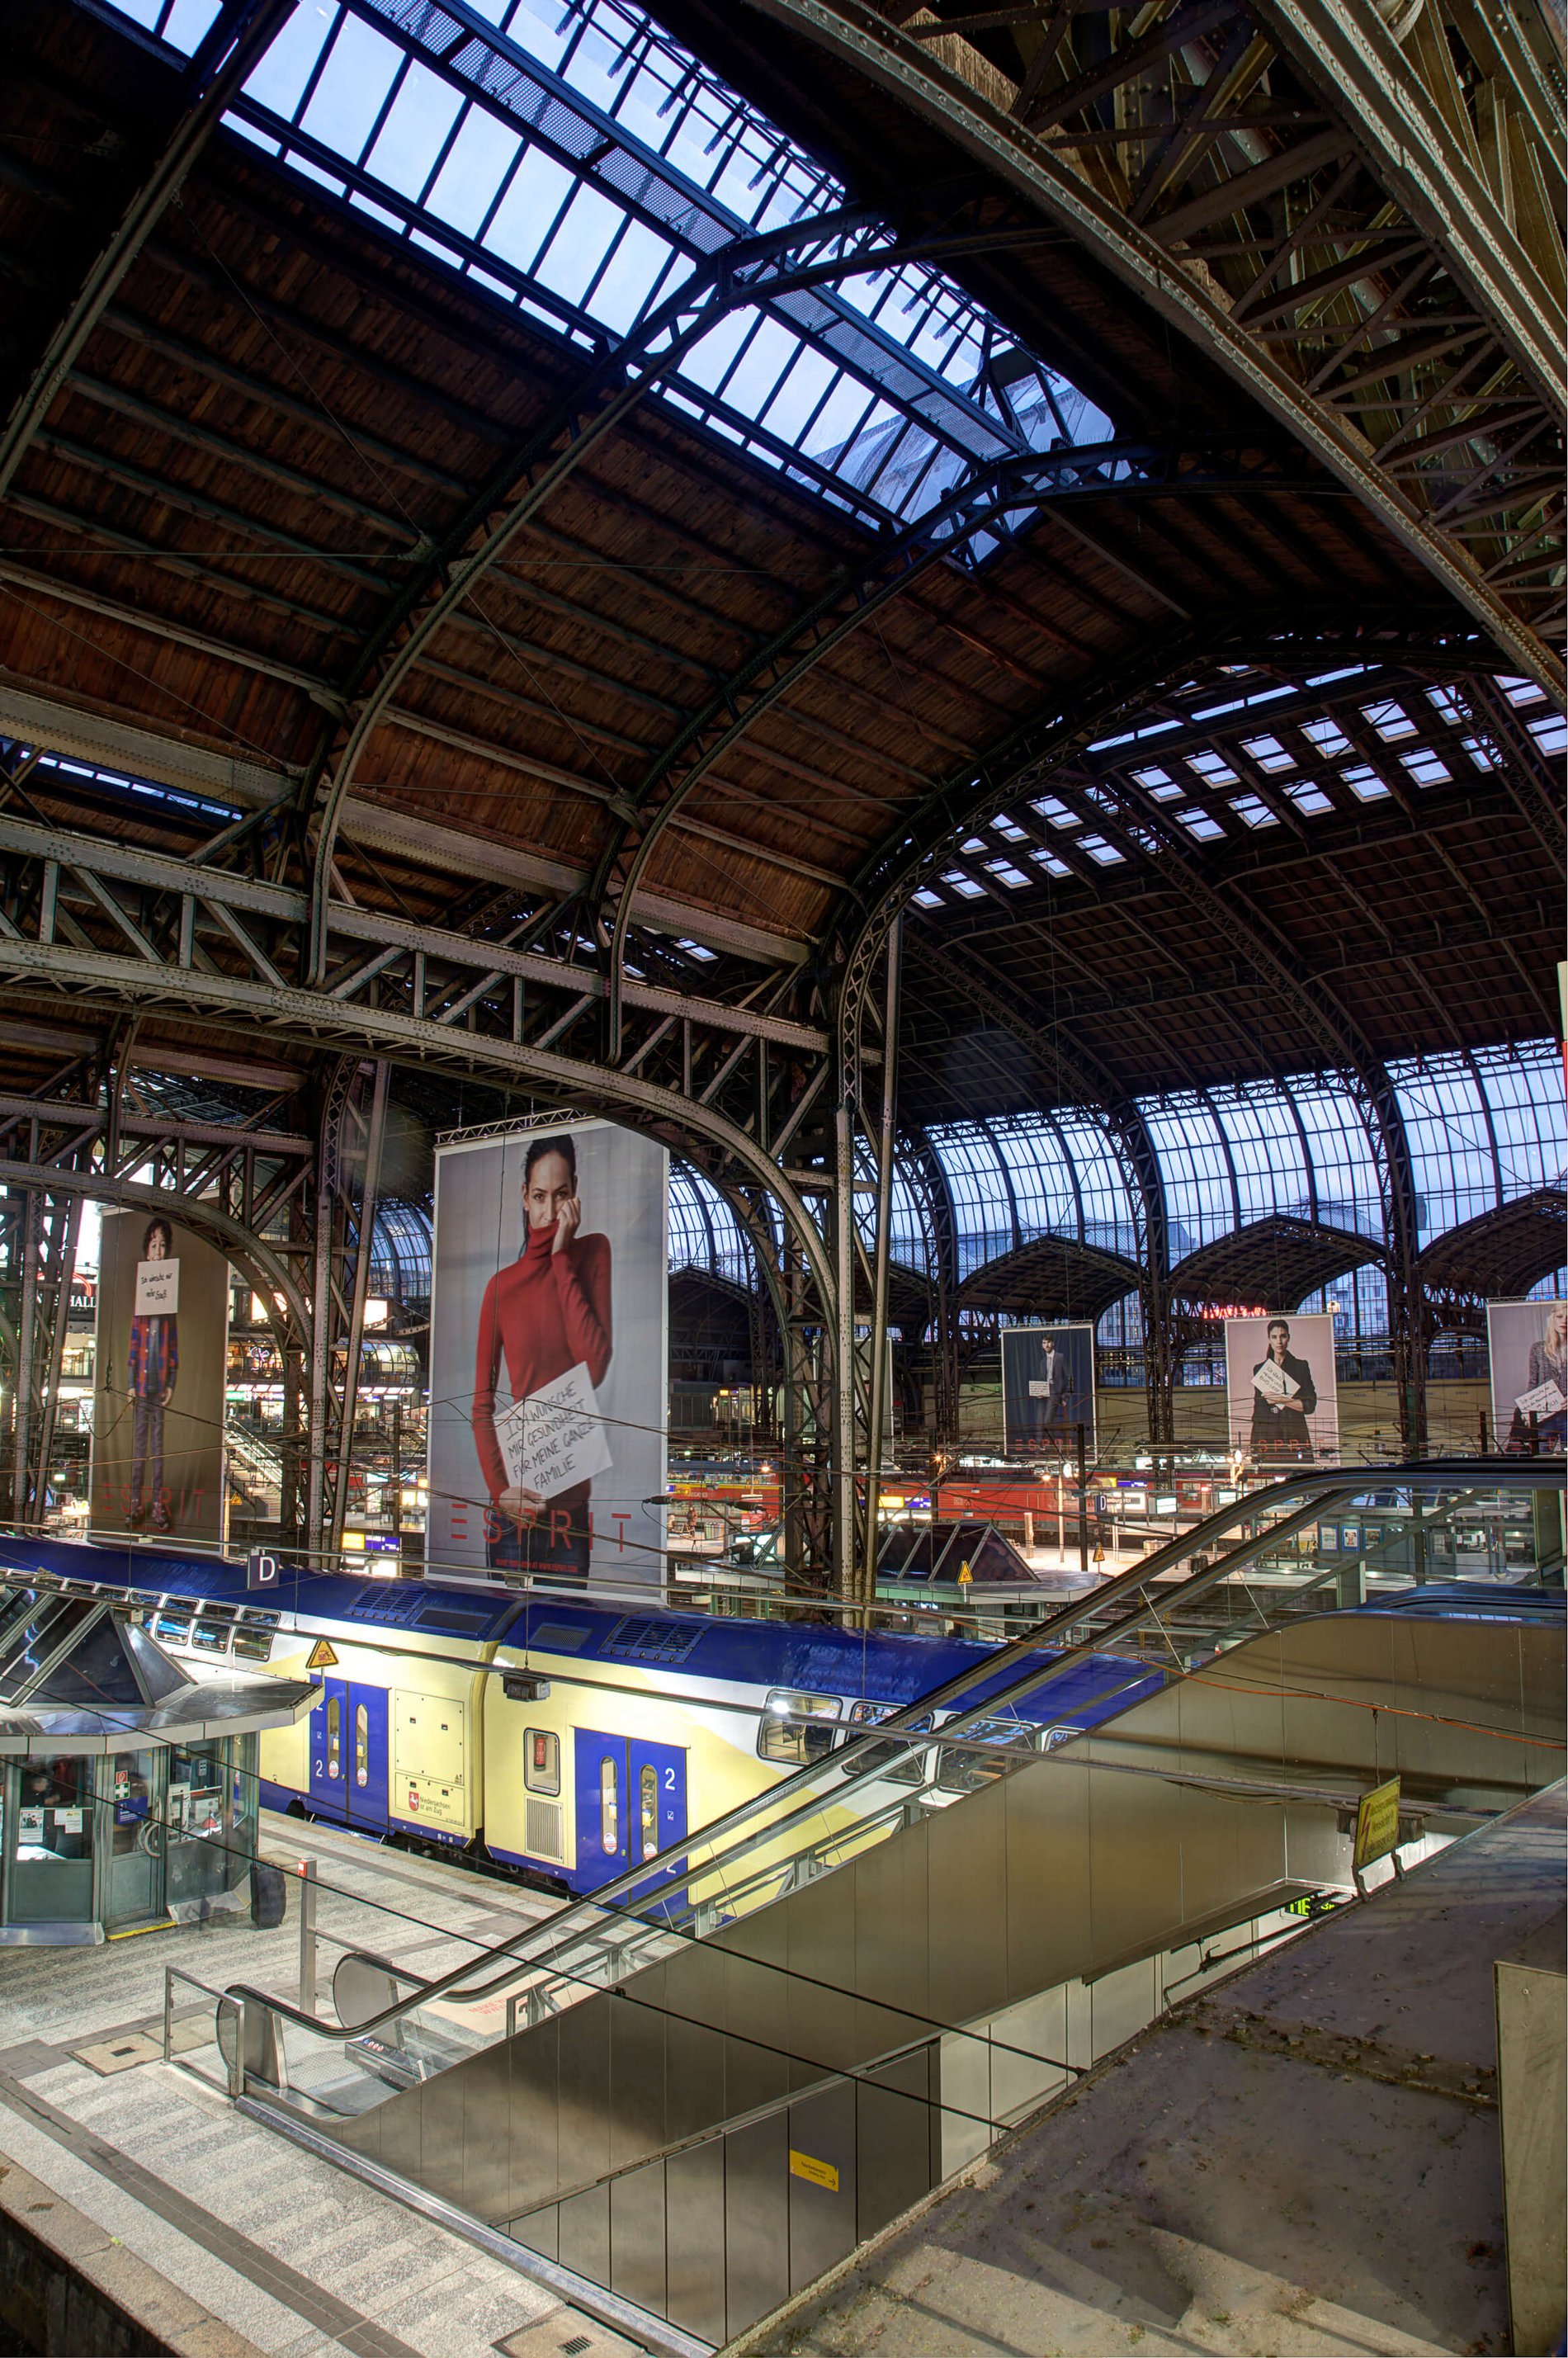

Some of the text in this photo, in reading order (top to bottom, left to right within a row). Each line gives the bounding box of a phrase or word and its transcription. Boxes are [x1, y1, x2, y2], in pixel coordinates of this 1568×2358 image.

[508, 1439, 527, 1459] MIR
[532, 1438, 561, 1467] MEINE
[1015, 1439, 1072, 1452] ESPRI
[533, 1453, 576, 1491] FAMILIE
[102, 1481, 205, 1519] ESPRIT
[451, 1503, 632, 1553] ESPRIT
[259, 1556, 276, 1582] D
[315, 1759, 324, 1778] 2
[664, 1767, 676, 1791] 2
